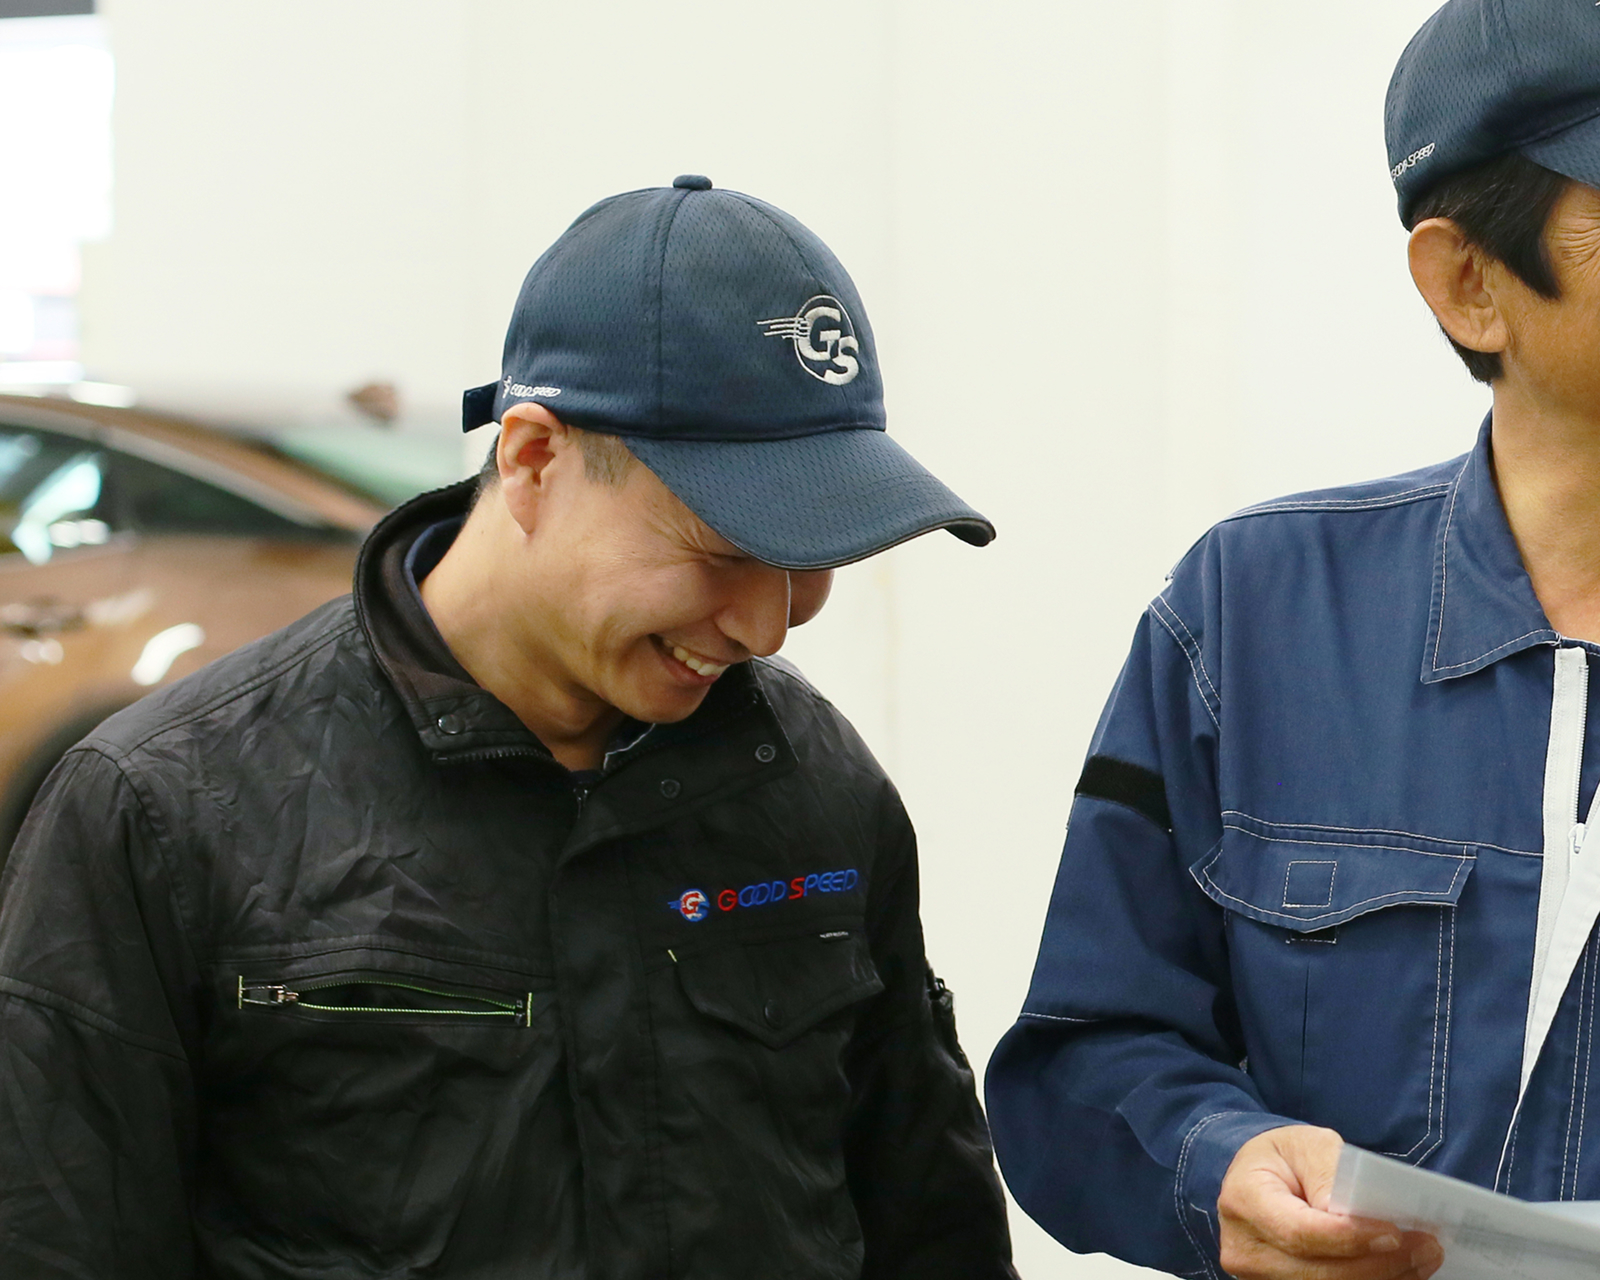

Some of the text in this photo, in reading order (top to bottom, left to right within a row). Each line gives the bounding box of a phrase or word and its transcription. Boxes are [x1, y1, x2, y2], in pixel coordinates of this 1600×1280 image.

[797, 305, 860, 386] GS
[717, 868, 859, 912] GOOD SPEED
